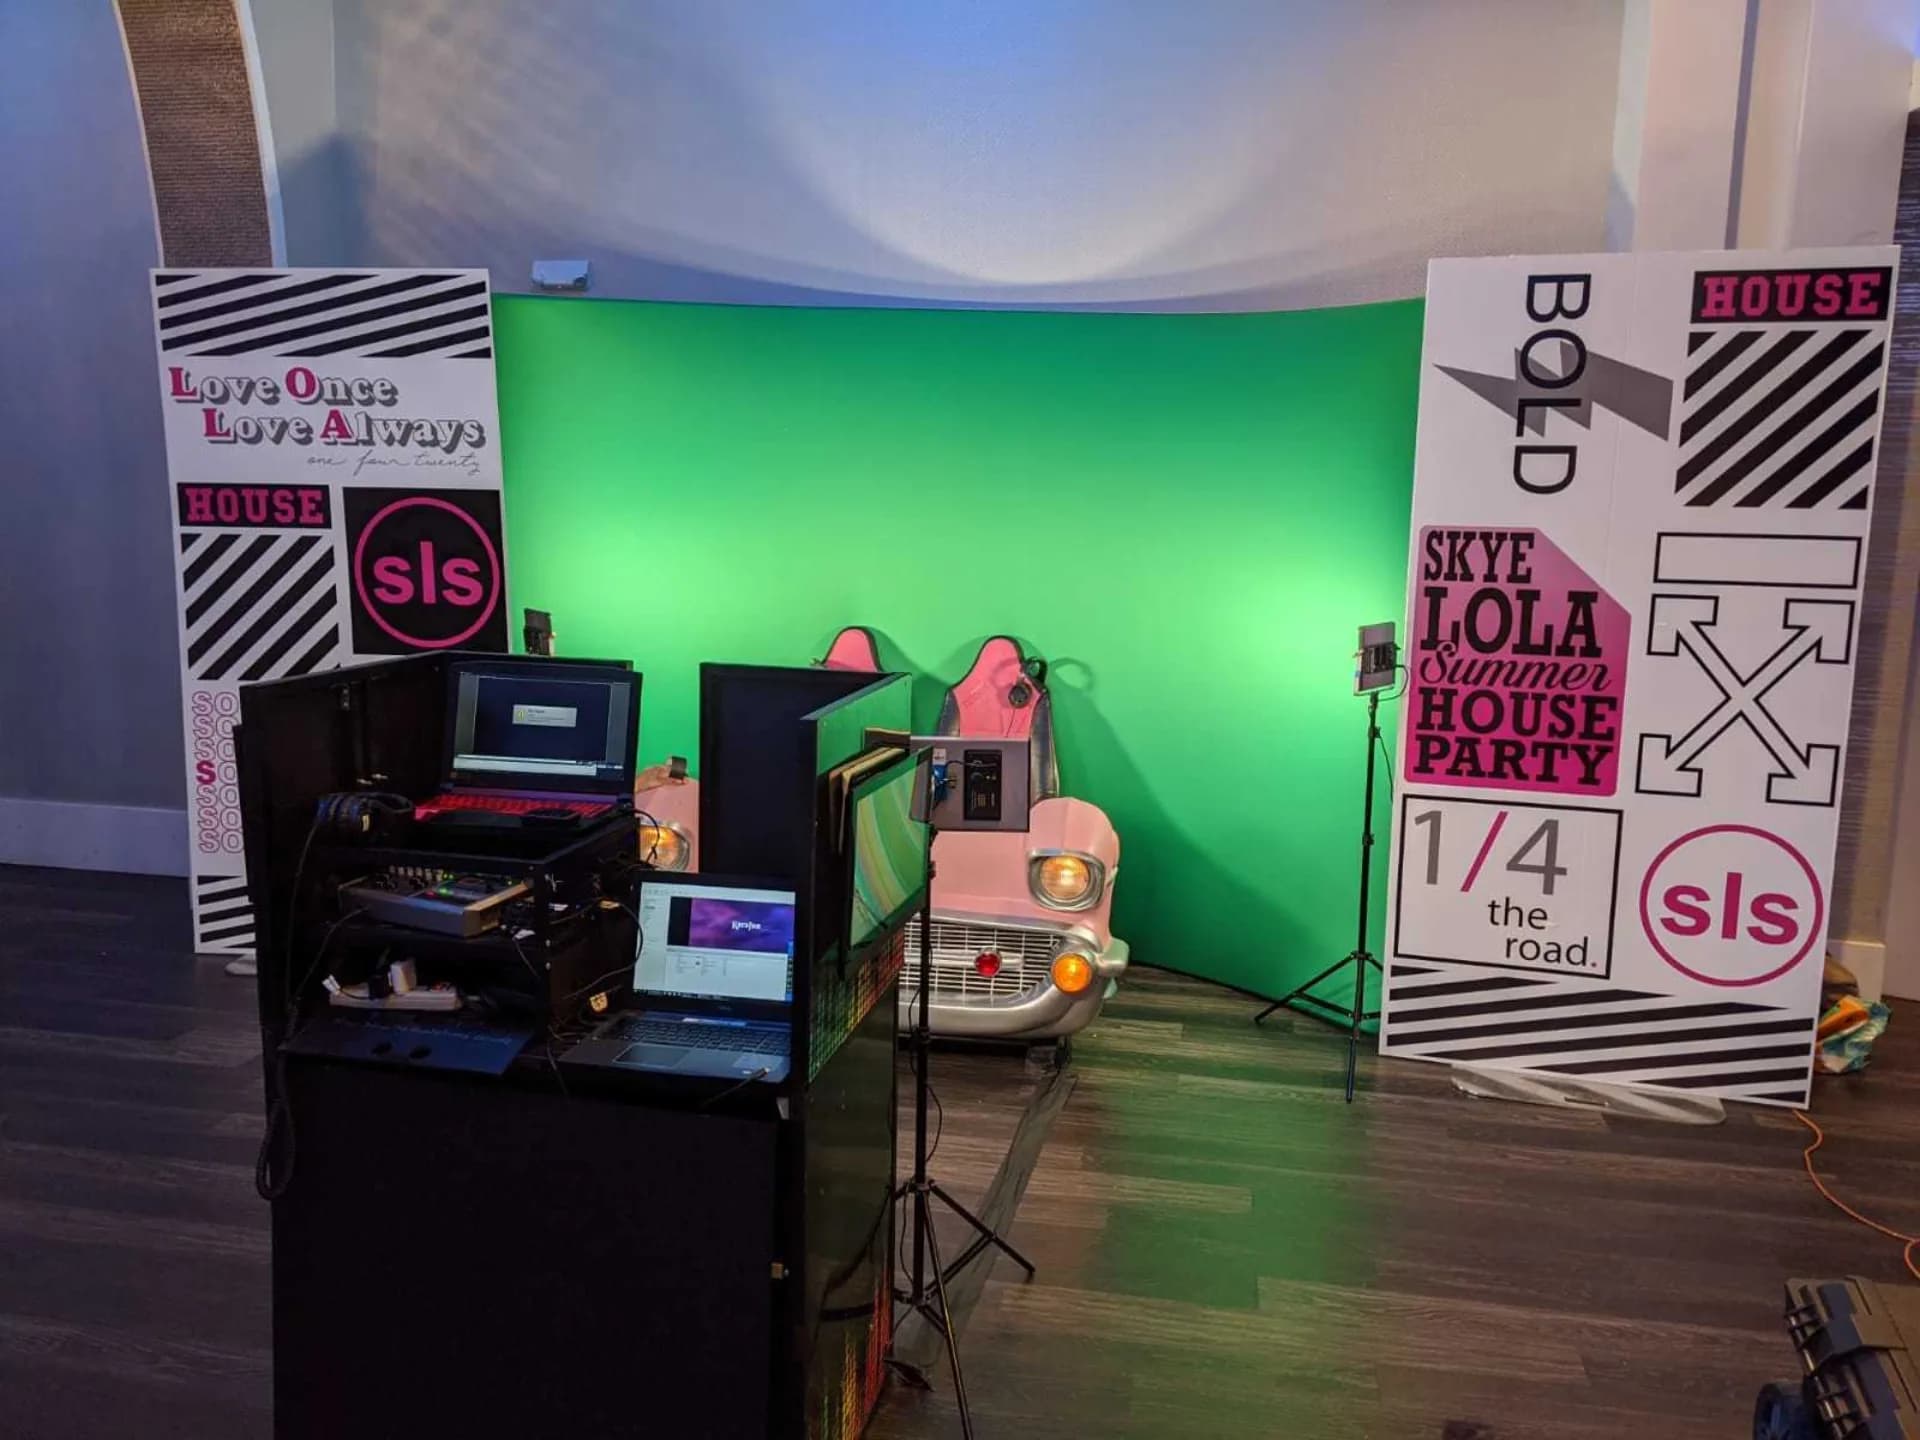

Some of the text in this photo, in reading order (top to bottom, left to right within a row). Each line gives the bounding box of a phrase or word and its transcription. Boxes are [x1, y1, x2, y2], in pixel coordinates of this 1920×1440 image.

[1701, 273, 1882, 318] HOUSE
[168, 366, 399, 406] Love Once
[1513, 273, 1592, 495] BOLD
[202, 408, 486, 454] Love Always
[307, 449, 480, 477] one four twenty
[183, 487, 324, 524] HOUSE
[373, 540, 484, 606] sls
[1423, 530, 1535, 583] SKYE
[1419, 586, 1603, 658] LOLA
[1420, 639, 1612, 691] Summer
[1416, 686, 1619, 742] HOUSE
[1413, 735, 1614, 786] PARTY
[1413, 809, 1568, 896] 1/4
[1488, 897, 1549, 930] the
[1659, 871, 1799, 945] sls
[1505, 936, 1598, 969] road.
